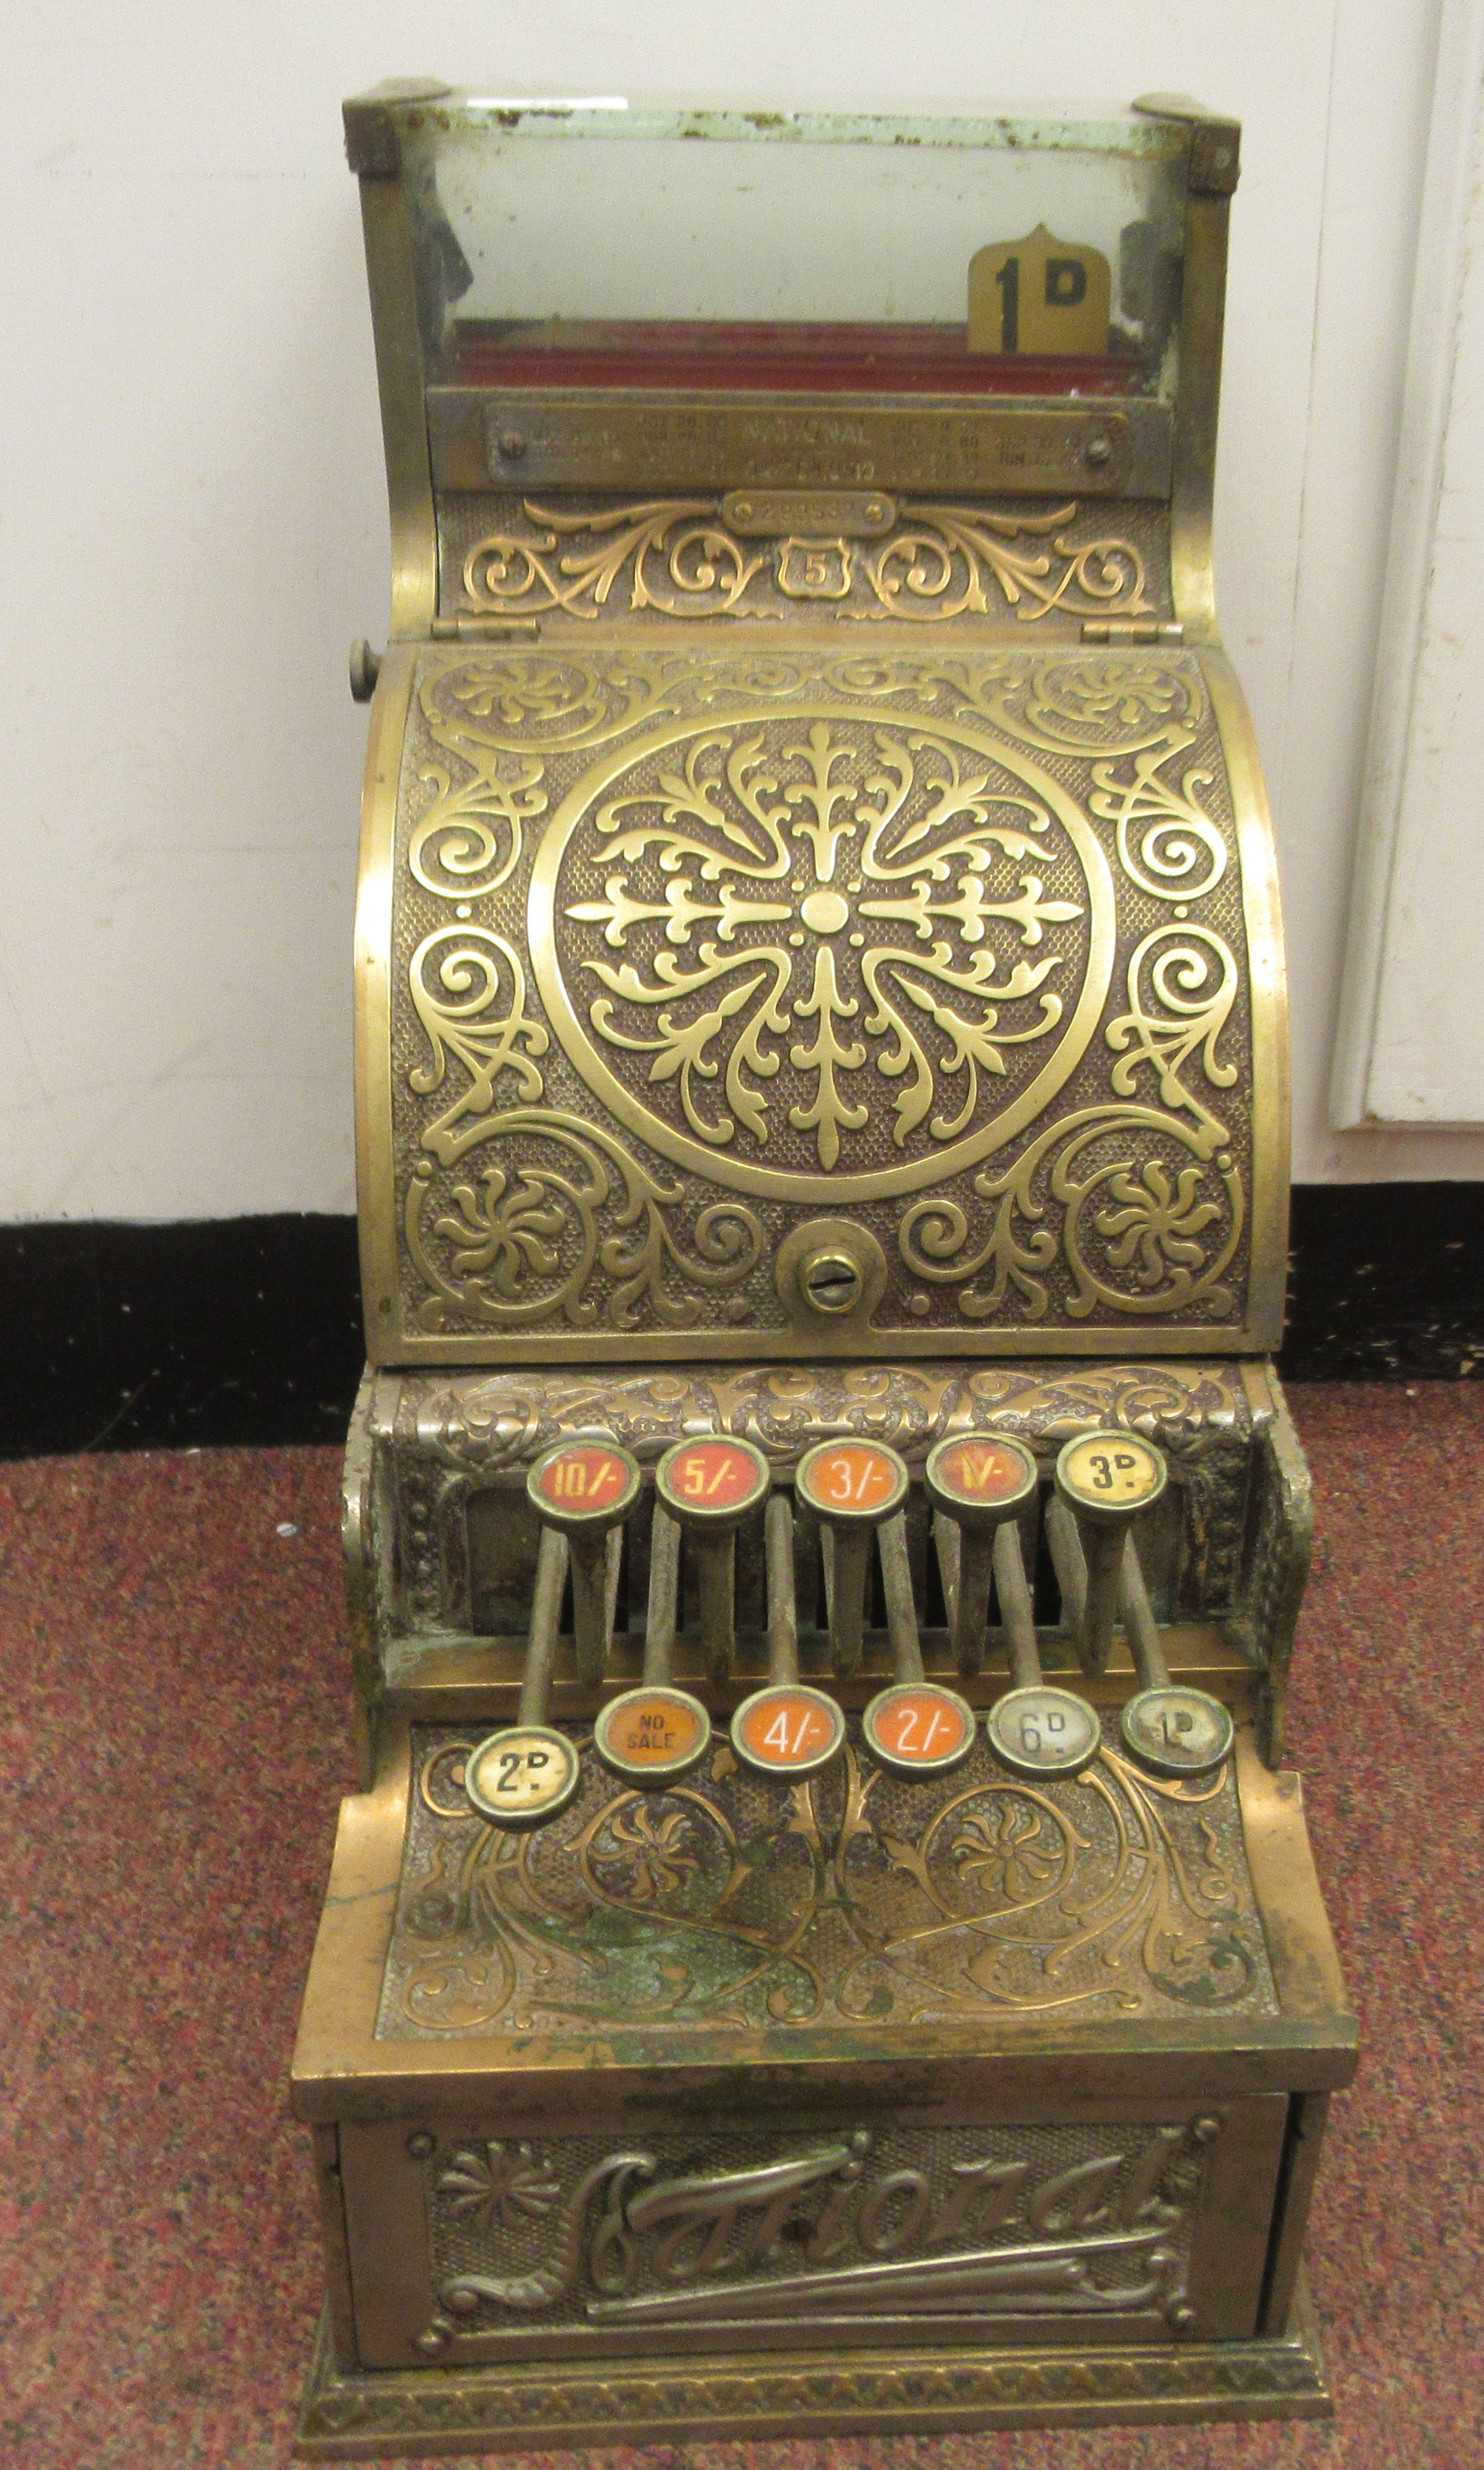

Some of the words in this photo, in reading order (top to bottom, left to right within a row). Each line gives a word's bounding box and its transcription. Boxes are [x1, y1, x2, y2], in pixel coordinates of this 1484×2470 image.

[805, 553, 827, 586] 5
[684, 1459, 735, 1495] 5/-
[830, 1459, 884, 1500] 3/-
[640, 1714, 665, 1731] NO
[763, 1710, 821, 1754] 4/-
[897, 1710, 950, 1752] 2/-
[627, 1732, 676, 1750] SALE
